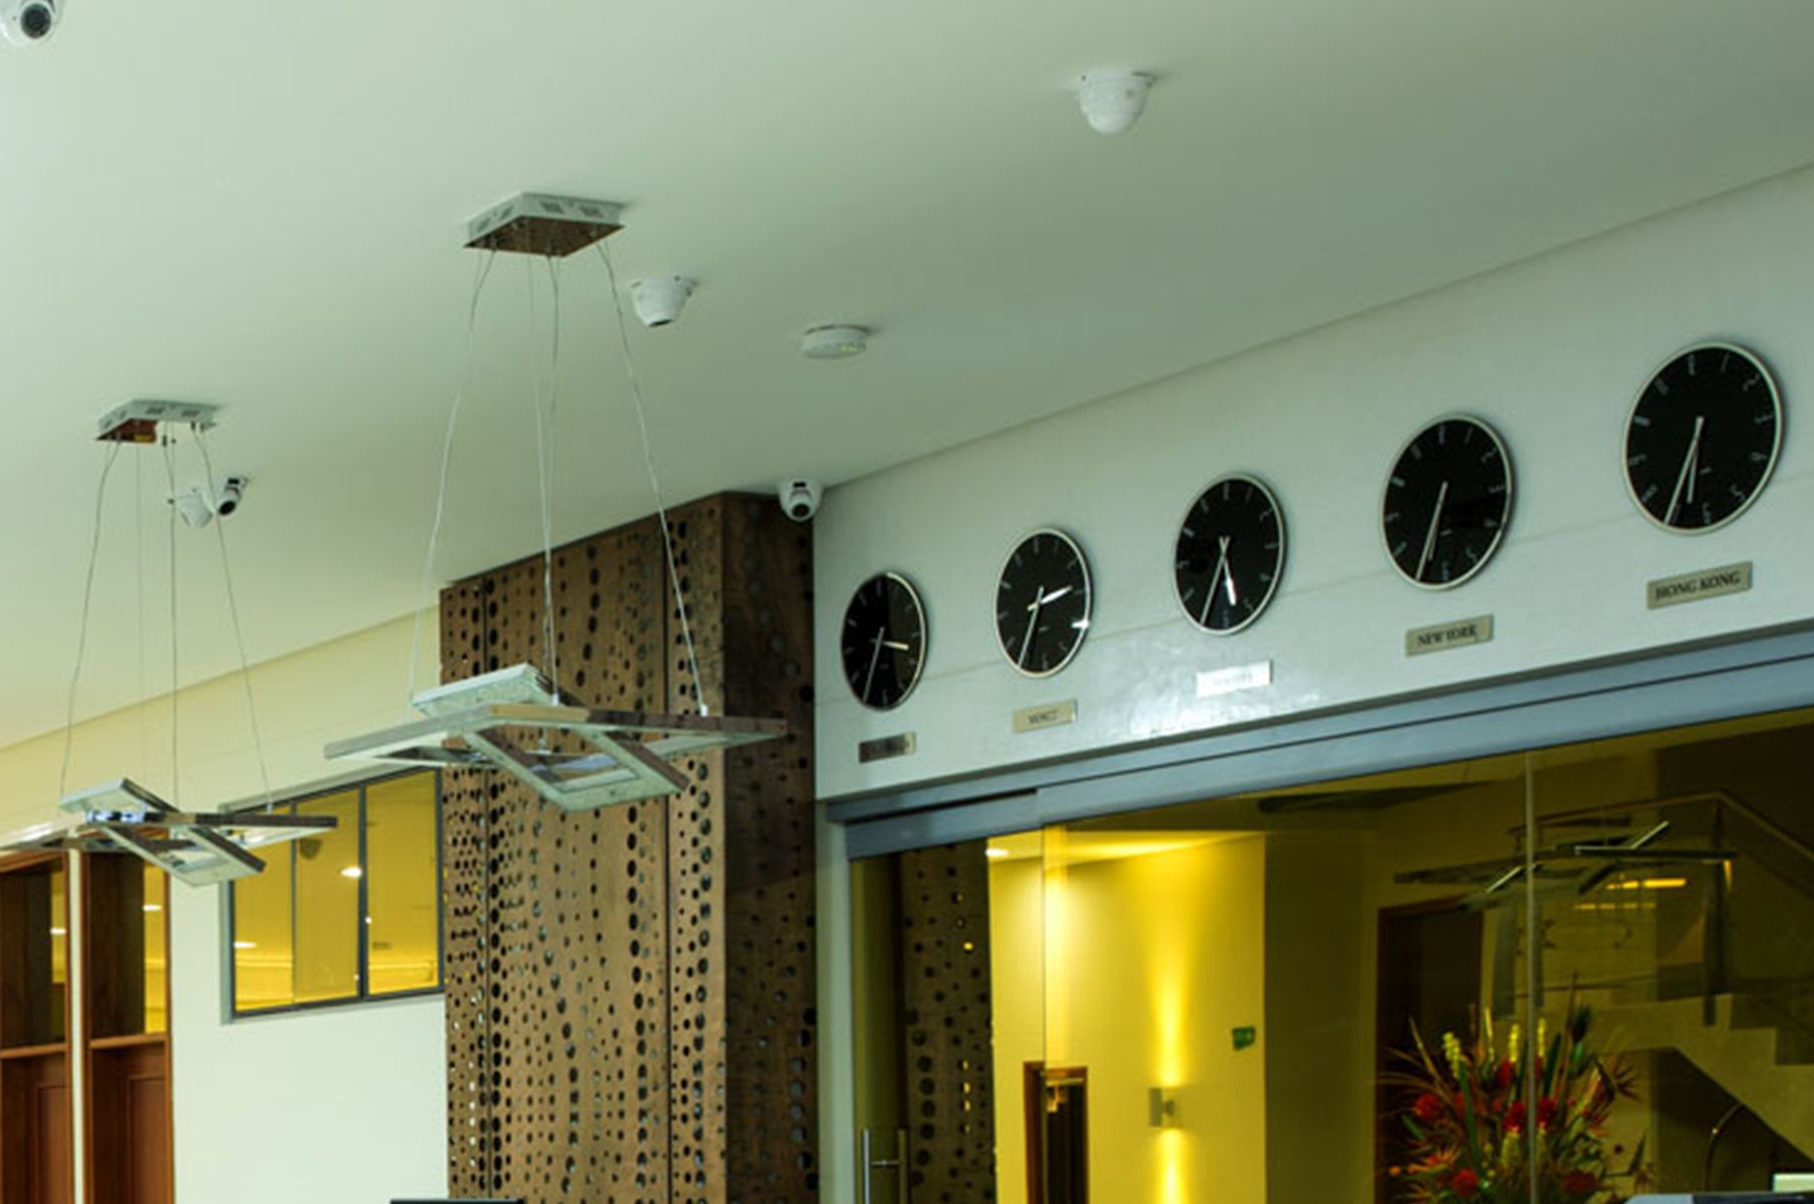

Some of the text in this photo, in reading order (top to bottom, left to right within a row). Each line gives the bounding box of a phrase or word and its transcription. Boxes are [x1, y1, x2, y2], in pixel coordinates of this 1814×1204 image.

[1655, 570, 1741, 600] HONG KONG
[1417, 631, 1444, 647] NEW
